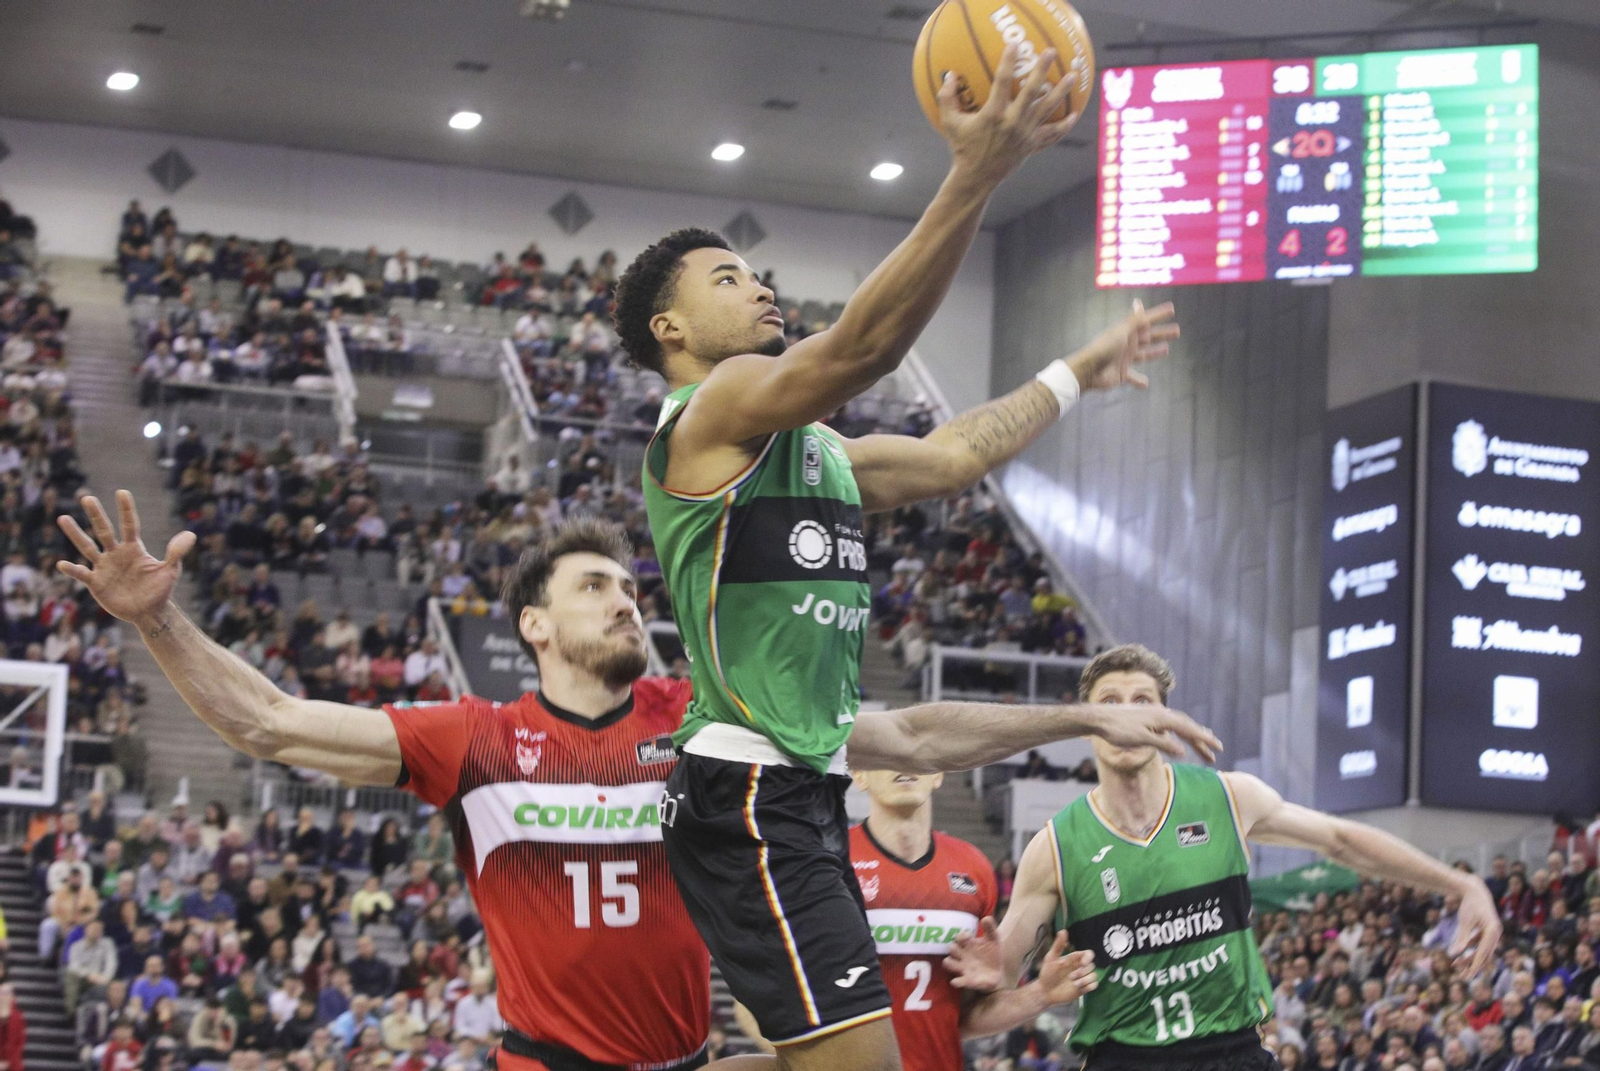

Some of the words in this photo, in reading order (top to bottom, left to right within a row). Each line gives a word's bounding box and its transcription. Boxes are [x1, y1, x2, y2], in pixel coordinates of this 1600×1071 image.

[1278, 229, 1302, 258] 4
[1325, 226, 1348, 256] 2
[514, 794, 661, 829] COVIRA
[564, 860, 640, 928] 15
[1136, 906, 1224, 950] PROBITAS
[903, 960, 933, 1011] 2
[1108, 943, 1230, 990] JOVENTUT
[1151, 990, 1195, 1042] 13
